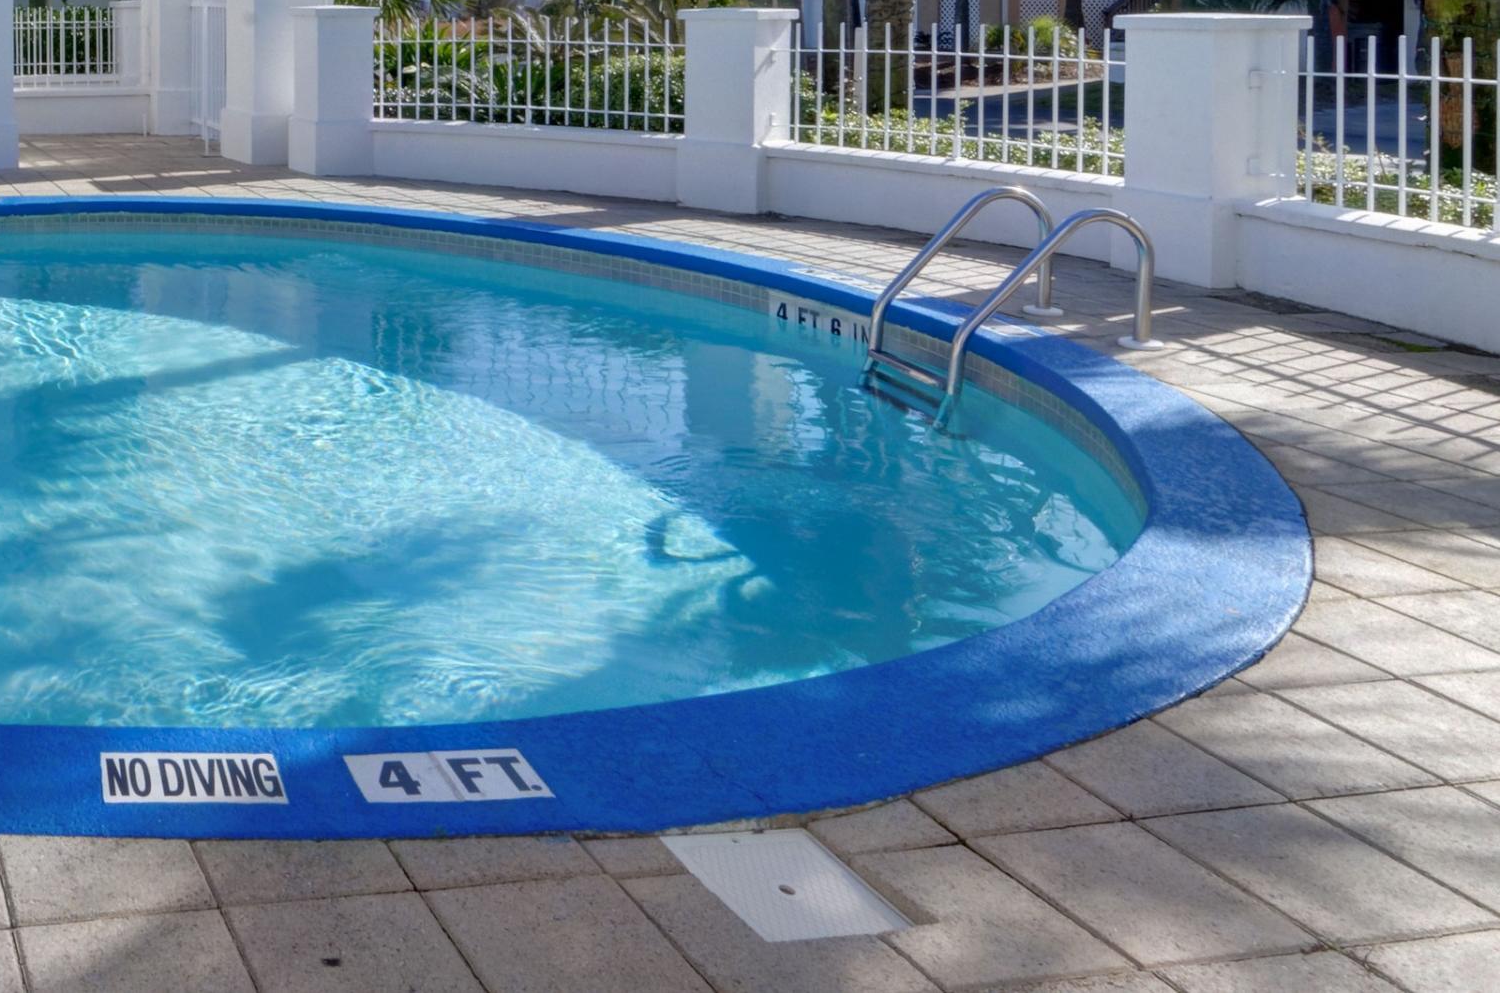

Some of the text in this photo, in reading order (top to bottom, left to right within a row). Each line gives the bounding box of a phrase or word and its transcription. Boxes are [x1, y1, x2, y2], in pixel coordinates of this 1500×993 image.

[777, 302, 788, 320] 4
[798, 307, 819, 328] FT
[830, 317, 841, 337] 6
[105, 758, 284, 797] NO DIVING
[379, 756, 543, 795] 4 FT.
